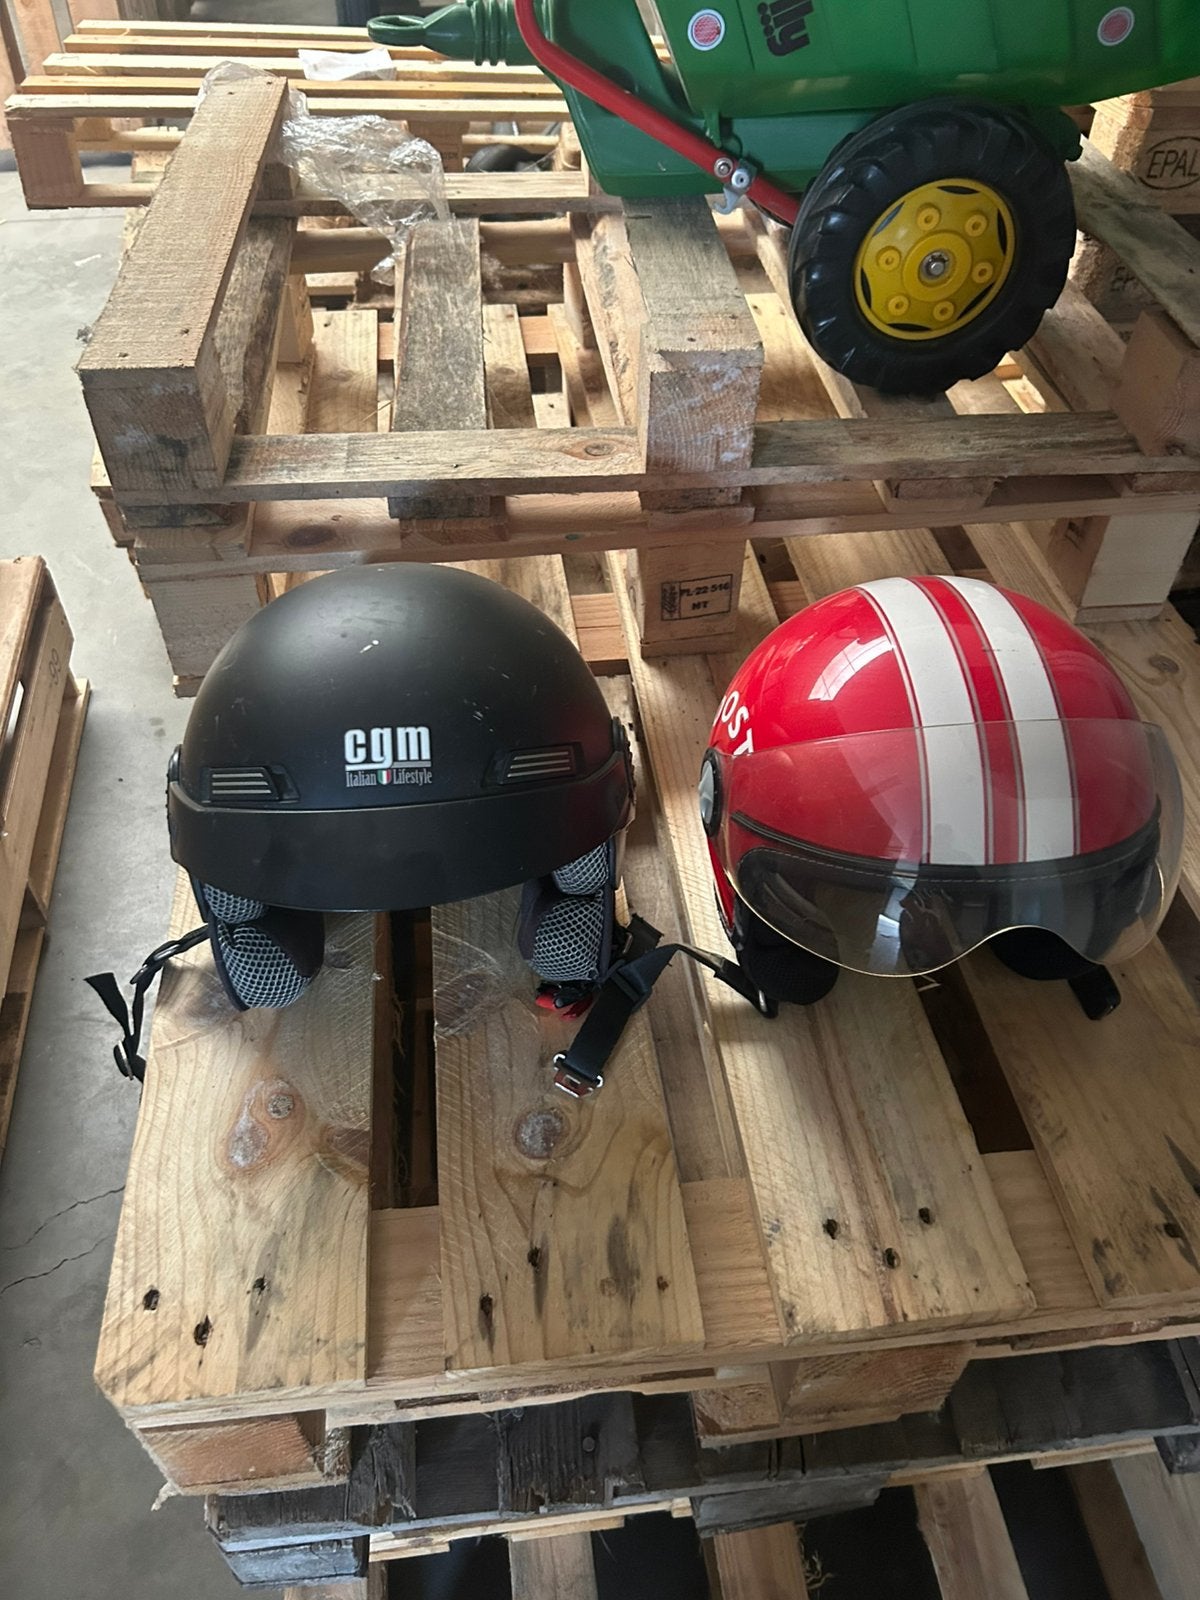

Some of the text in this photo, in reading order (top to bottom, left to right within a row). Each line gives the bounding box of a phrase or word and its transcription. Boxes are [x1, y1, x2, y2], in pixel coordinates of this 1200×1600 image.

[1146, 148, 1199, 179] EPAL
[712, 690, 755, 758] OST
[344, 726, 432, 772] cgm
[345, 768, 432, 788] Italian Lifestyle
